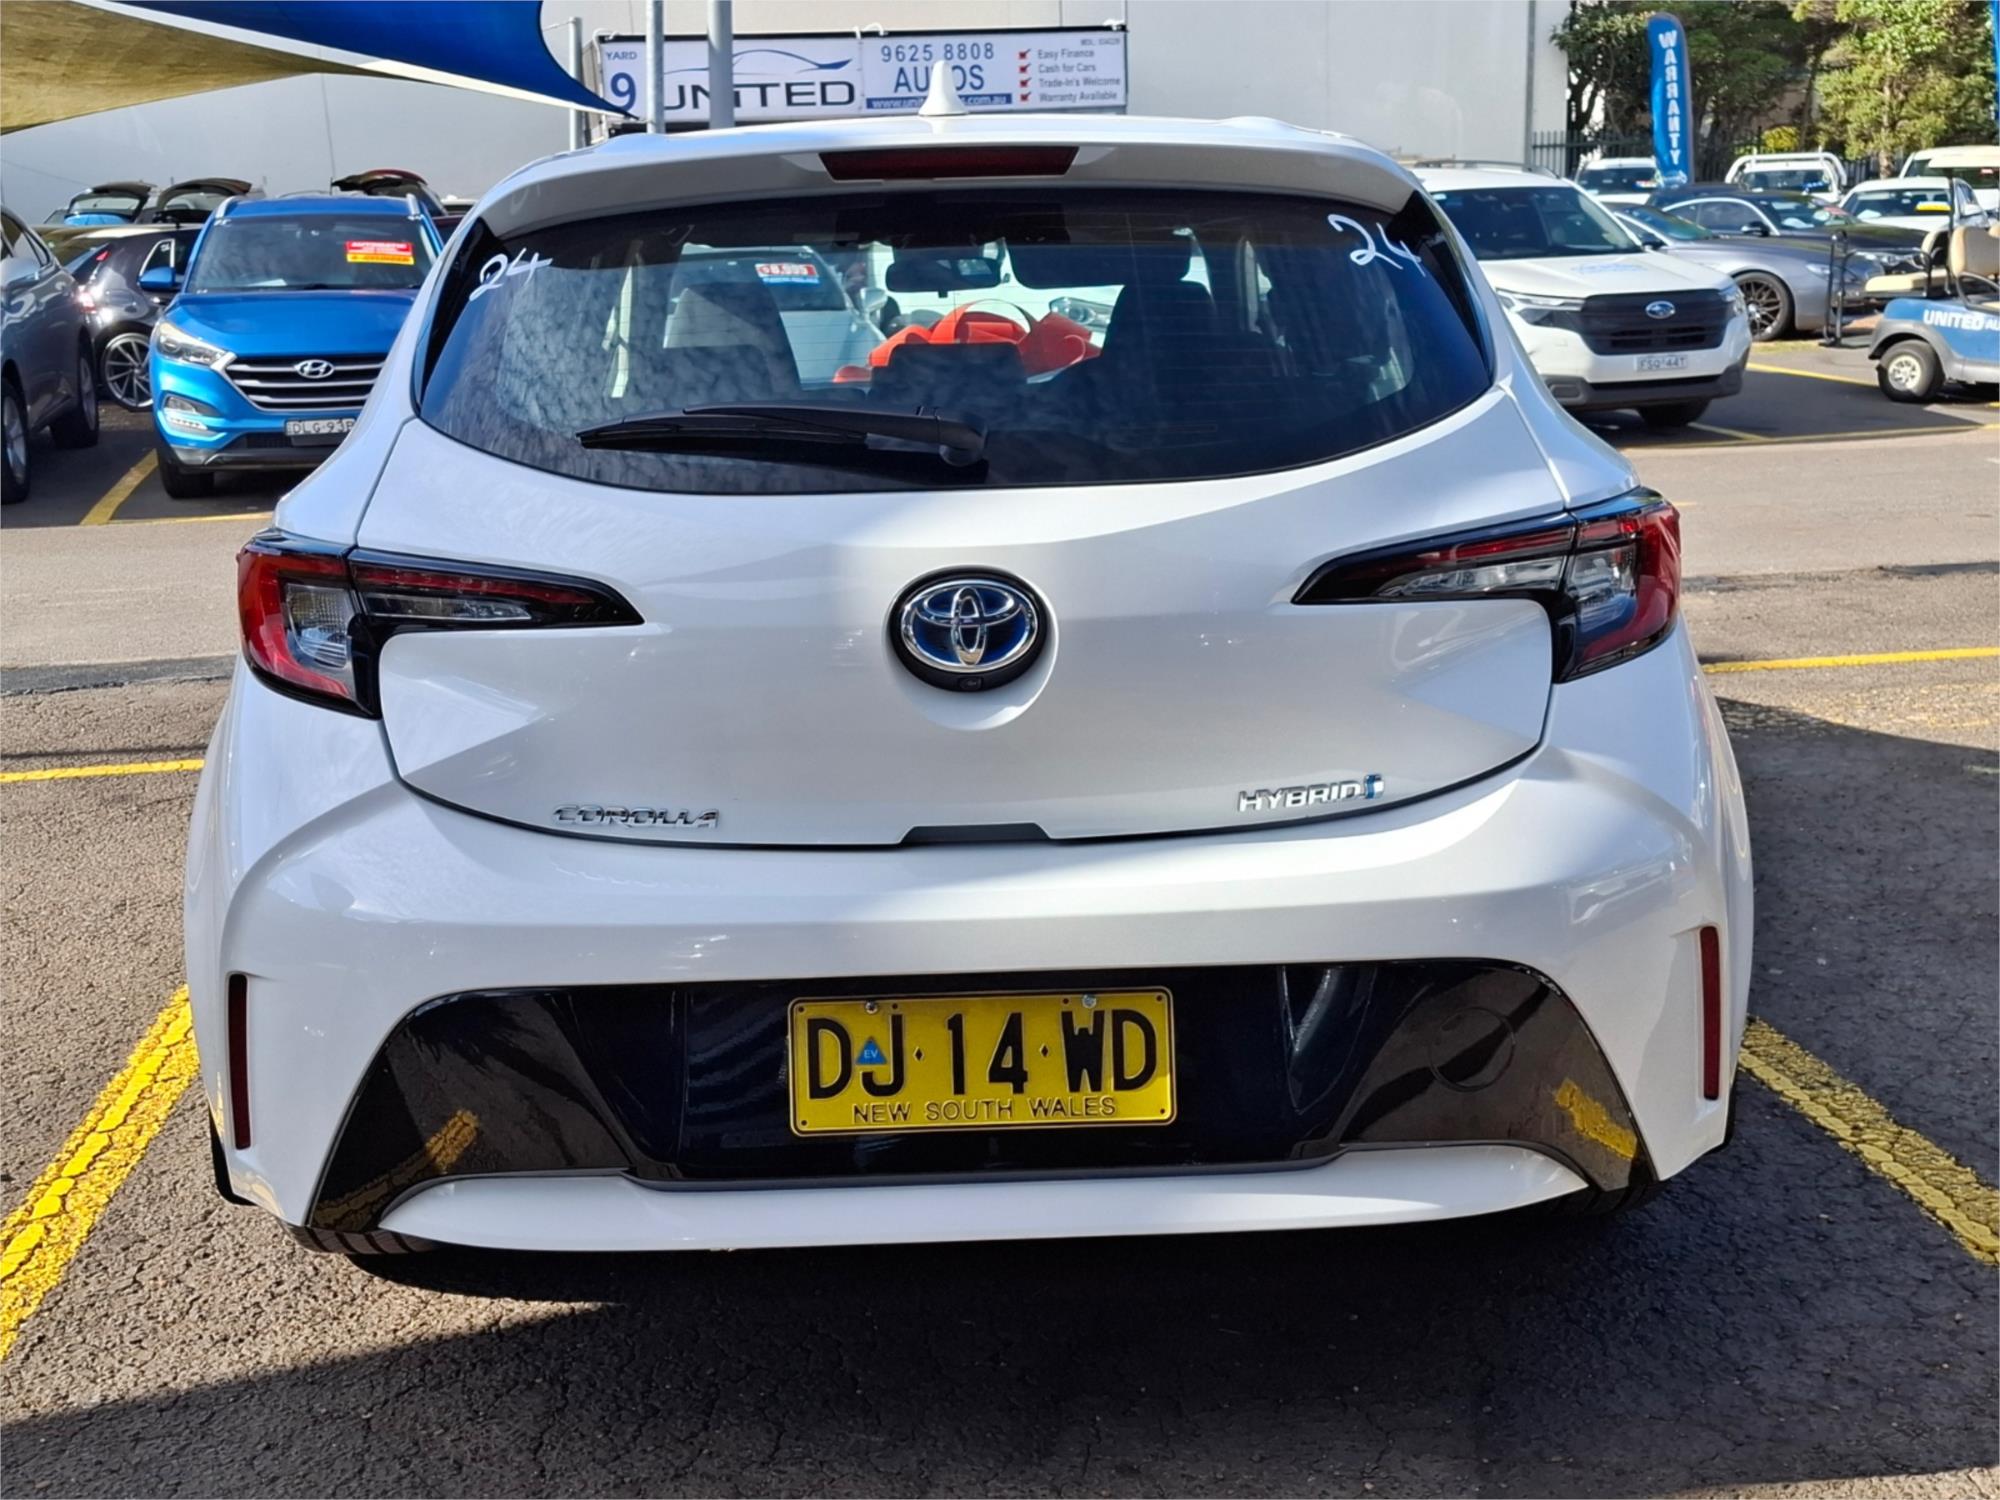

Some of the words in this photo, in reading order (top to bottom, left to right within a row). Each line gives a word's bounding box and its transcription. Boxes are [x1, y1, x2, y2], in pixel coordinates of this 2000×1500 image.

[605, 51, 638, 61] YARD
[881, 44, 934, 63] 9625
[943, 42, 995, 61] 8808
[1038, 49, 1059, 61] Easy
[1061, 48, 1095, 58] Finance
[893, 64, 985, 93] AUOS
[1038, 64, 1060, 74] Cash
[1062, 63, 1075, 72] for
[1076, 62, 1096, 72] Cars
[610, 72, 637, 112] 9
[1083, 77, 1120, 86] Welcome
[1039, 92, 1077, 103] Warranty
[1080, 90, 1117, 101] Available
[1327, 213, 1426, 277] 24
[1923, 309, 1984, 331] UNITED
[292, 422, 321, 434] DLG
[1238, 780, 1361, 812] HYBRID
[552, 804, 719, 829] COROLLA
[807, 1013, 905, 1100] DJ
[945, 1012, 1029, 1096] 14
[1061, 1009, 1157, 1094] WD
[863, 1049, 879, 1059] EV
[852, 1101, 911, 1124] NEW
[925, 1098, 1013, 1122] SOUTH
[1029, 1095, 1116, 1118] WALES
